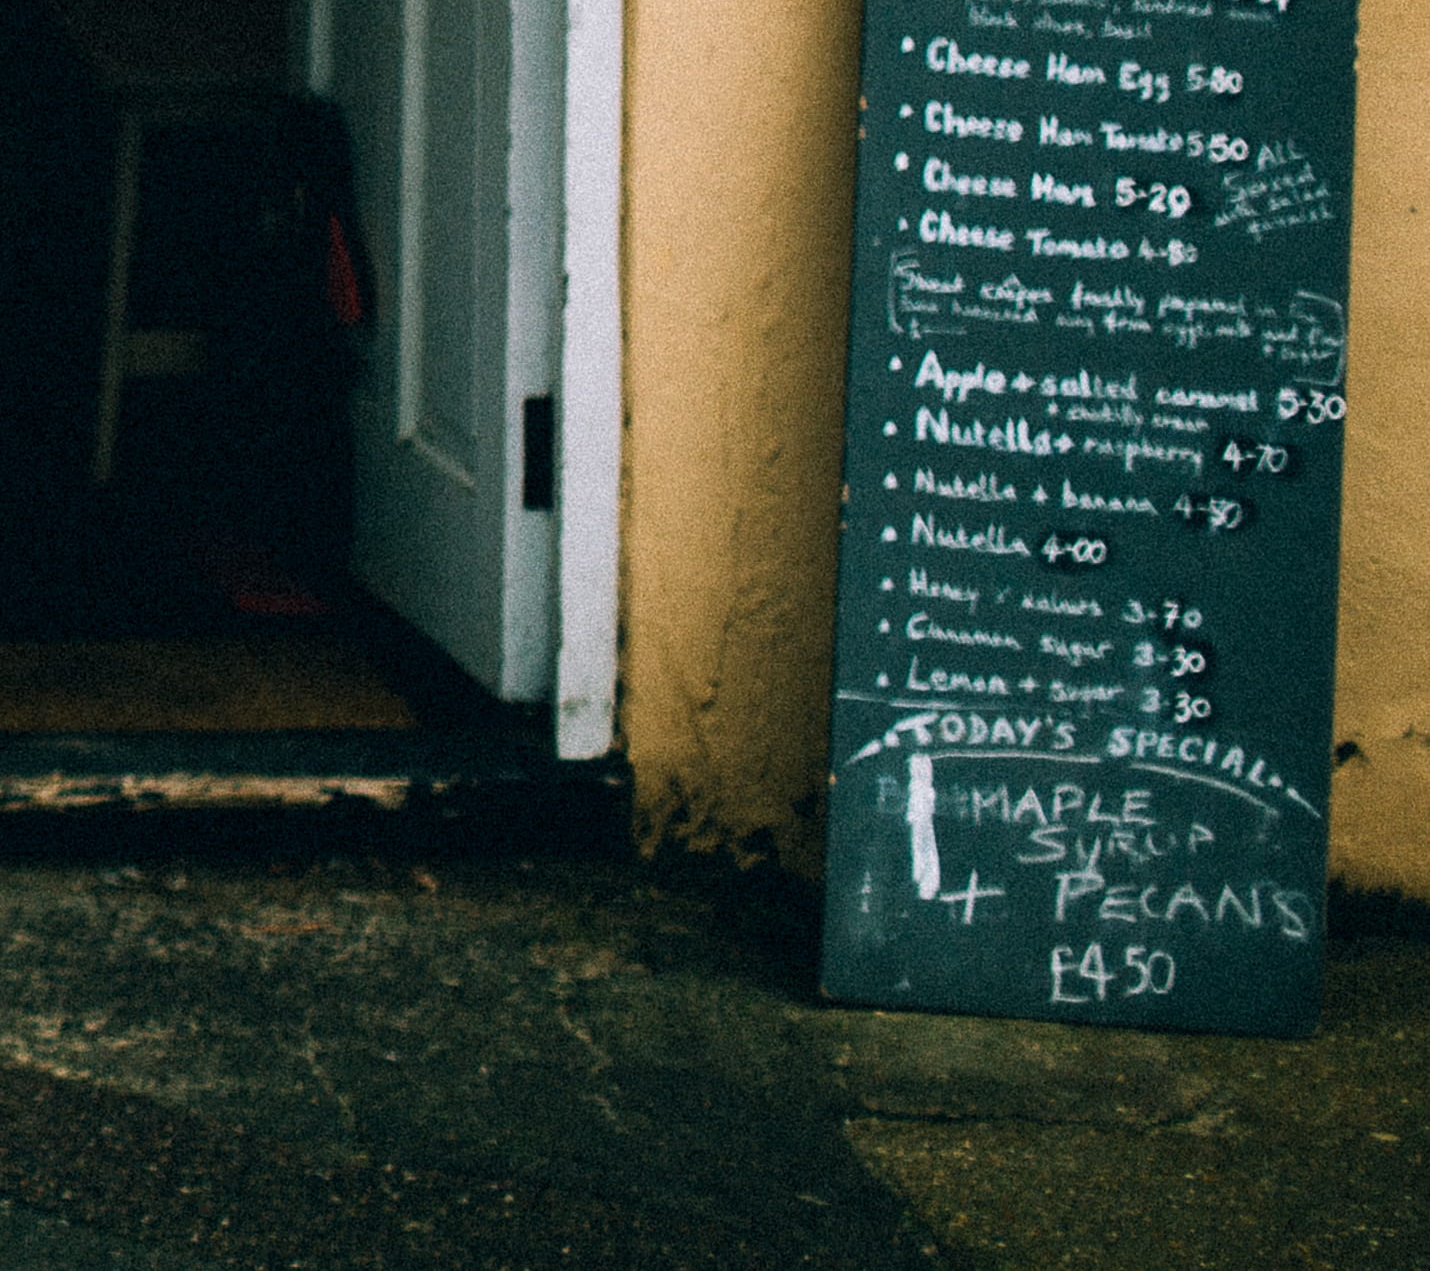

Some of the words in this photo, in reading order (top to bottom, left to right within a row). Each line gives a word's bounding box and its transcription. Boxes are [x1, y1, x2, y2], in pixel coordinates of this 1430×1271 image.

[926, 36, 1031, 79] Cheese
[1046, 52, 1106, 85] Ham
[1118, 61, 1170, 103] Egg
[924, 101, 1023, 143] Cheese
[1039, 115, 1092, 147] Ham
[923, 157, 1018, 199] Cheese
[1031, 172, 1096, 208] Ham
[919, 209, 1014, 251] Cheese
[1026, 227, 1130, 261] Tomato
[915, 348, 1006, 403] Apple
[1041, 366, 1138, 401] salted
[1155, 386, 1259, 414] caramel
[915, 405, 1051, 457] Nutella
[914, 466, 1017, 503] Nutella
[1062, 477, 1159, 516] banana
[911, 511, 1032, 557] Nutella
[905, 655, 1011, 696] Lemon
[894, 711, 1077, 751] TODAY'S
[971, 784, 1157, 827] MAPLE
[1018, 821, 1216, 873] SYRUP
[1056, 871, 1309, 942] PECANS
